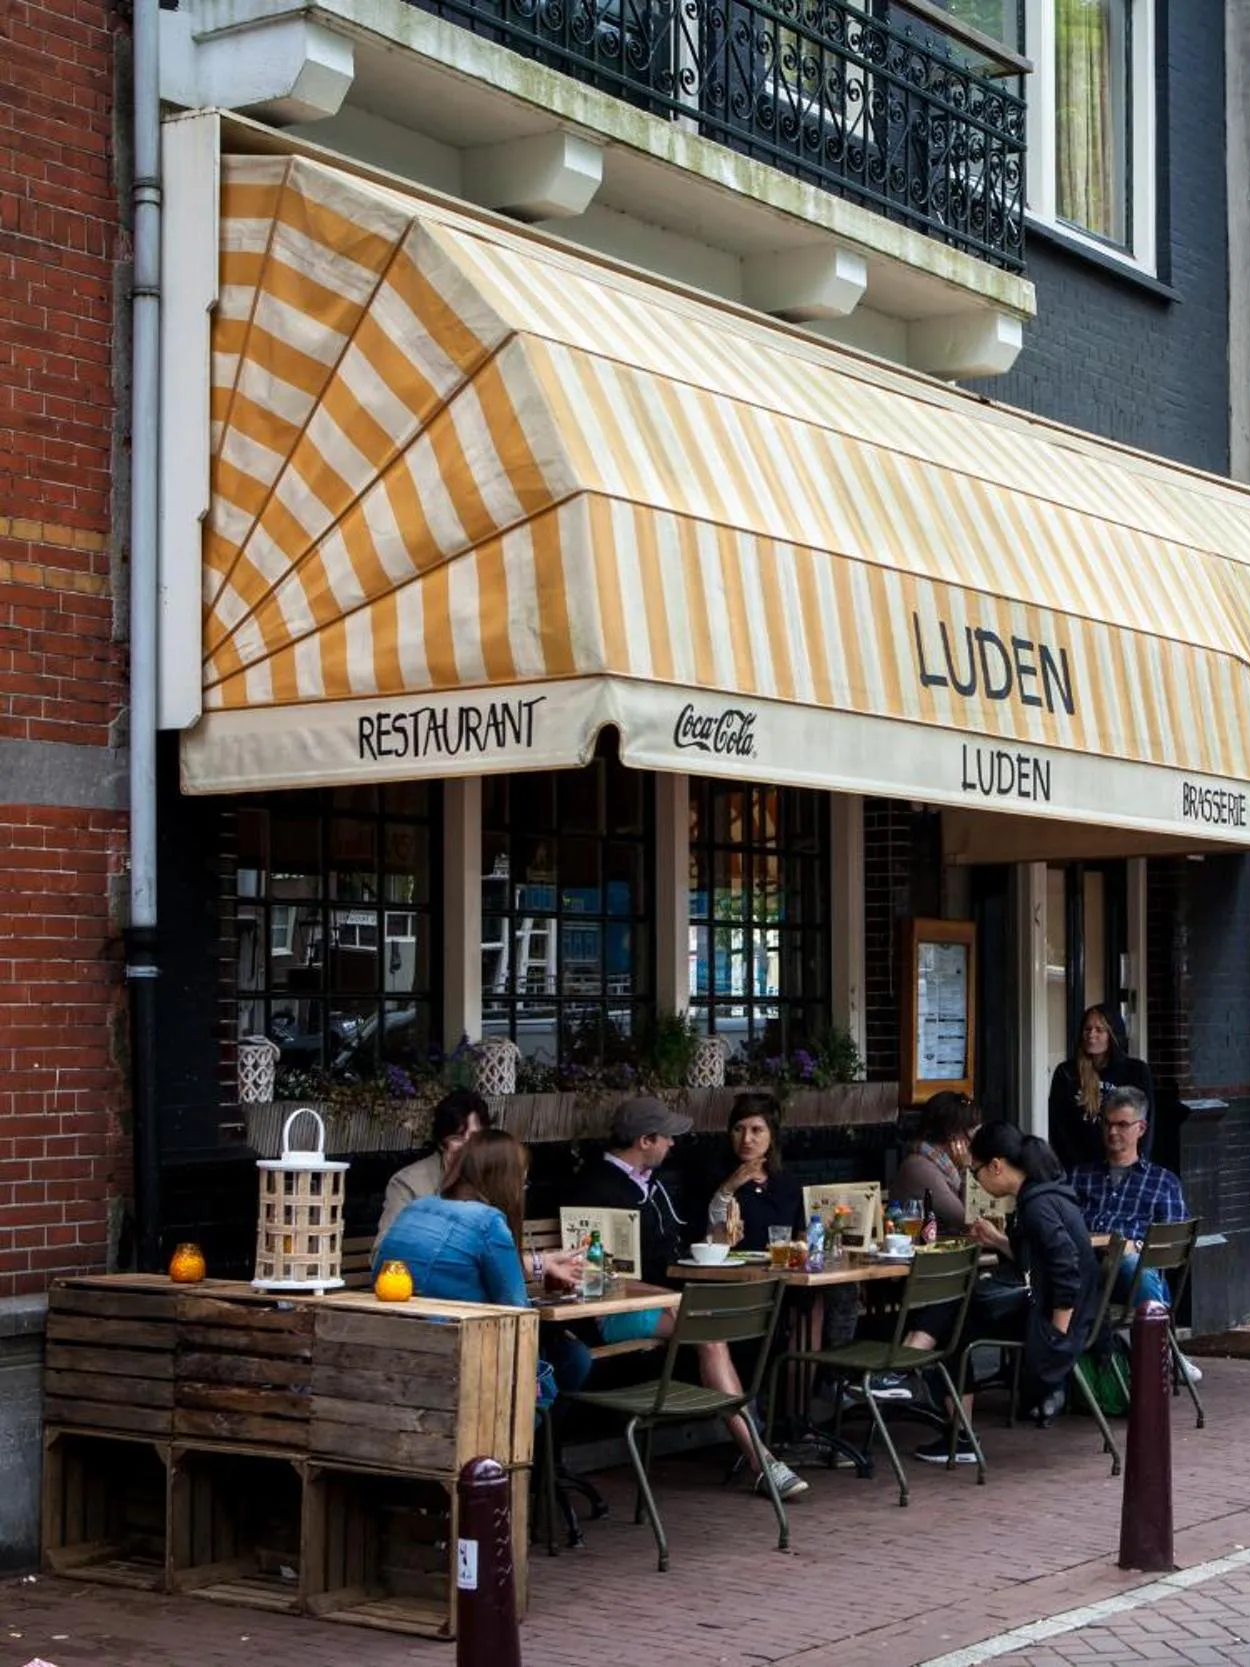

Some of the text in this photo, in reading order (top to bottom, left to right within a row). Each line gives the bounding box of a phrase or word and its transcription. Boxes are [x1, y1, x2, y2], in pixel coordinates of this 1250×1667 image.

[912, 611, 1076, 716] LUDEN
[358, 696, 547, 761] RESTAURANT
[673, 703, 757, 756] Coca-Cola
[961, 744, 1051, 801] LUDEN
[1182, 781, 1247, 827] BRASSERIE
